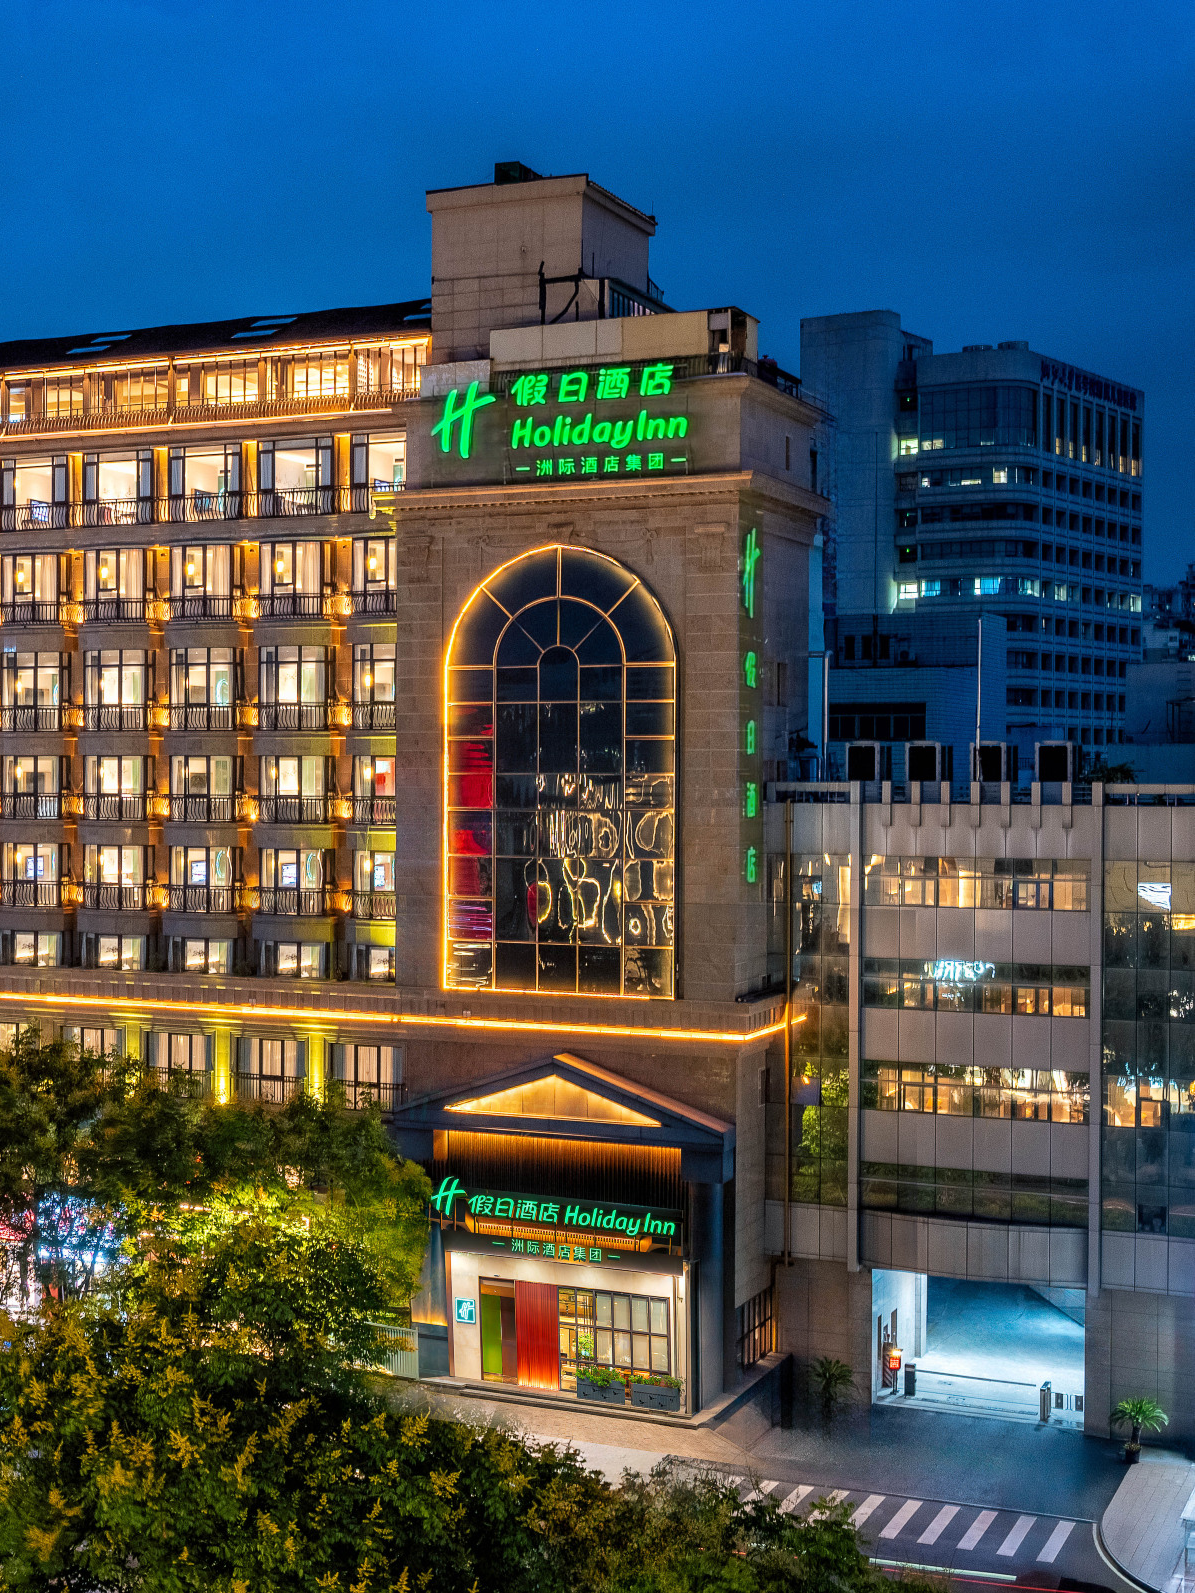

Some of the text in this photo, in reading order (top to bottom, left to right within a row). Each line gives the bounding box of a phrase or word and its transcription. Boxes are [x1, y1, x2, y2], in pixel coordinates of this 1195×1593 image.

[510, 362, 675, 407] 假日酒店
[536, 452, 665, 477] 洲际酒店集团
[467, 1194, 561, 1223] 假日酒店
[564, 1205, 676, 1236] Holiday Inn
[511, 1238, 603, 1263] 洲际酒店集团
